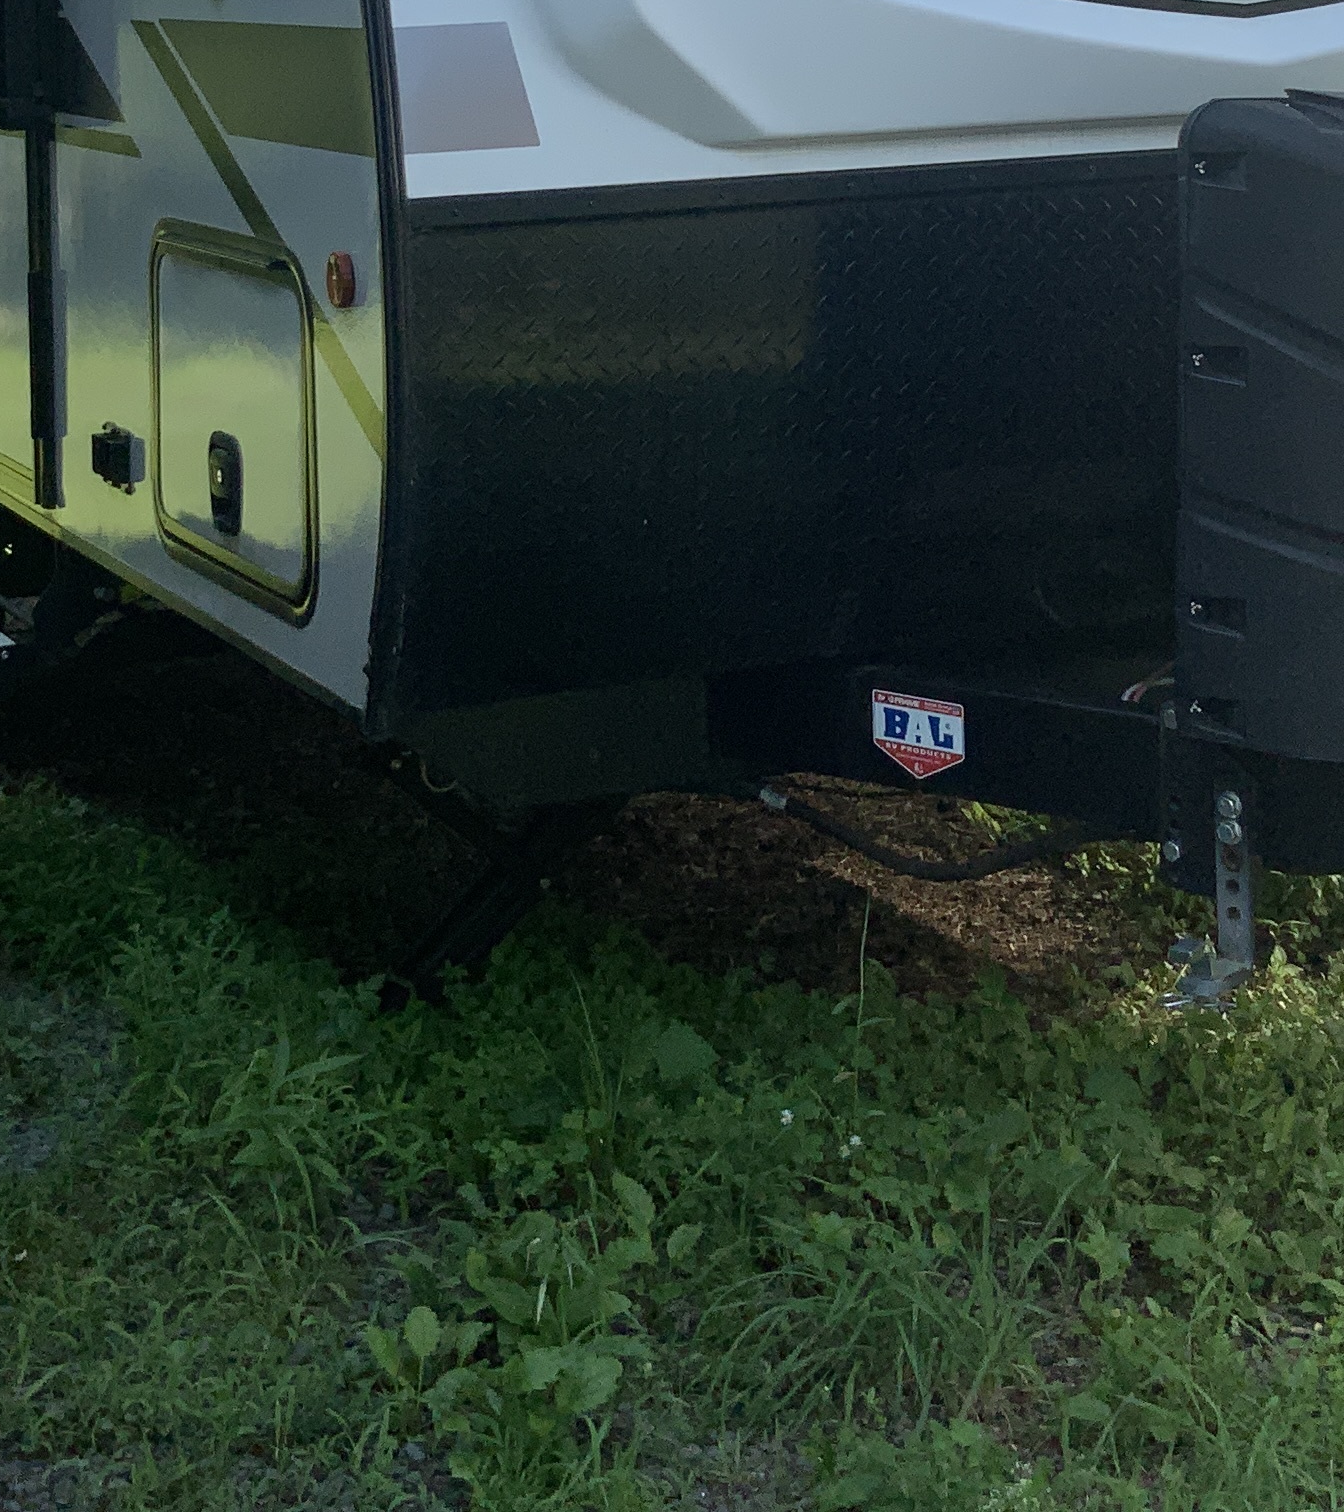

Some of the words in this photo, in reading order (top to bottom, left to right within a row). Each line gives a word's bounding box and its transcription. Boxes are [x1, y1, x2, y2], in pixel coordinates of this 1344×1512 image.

[883, 707, 953, 750] BAL
[886, 742, 898, 750] RV
[900, 744, 952, 760] PRODUCTS
